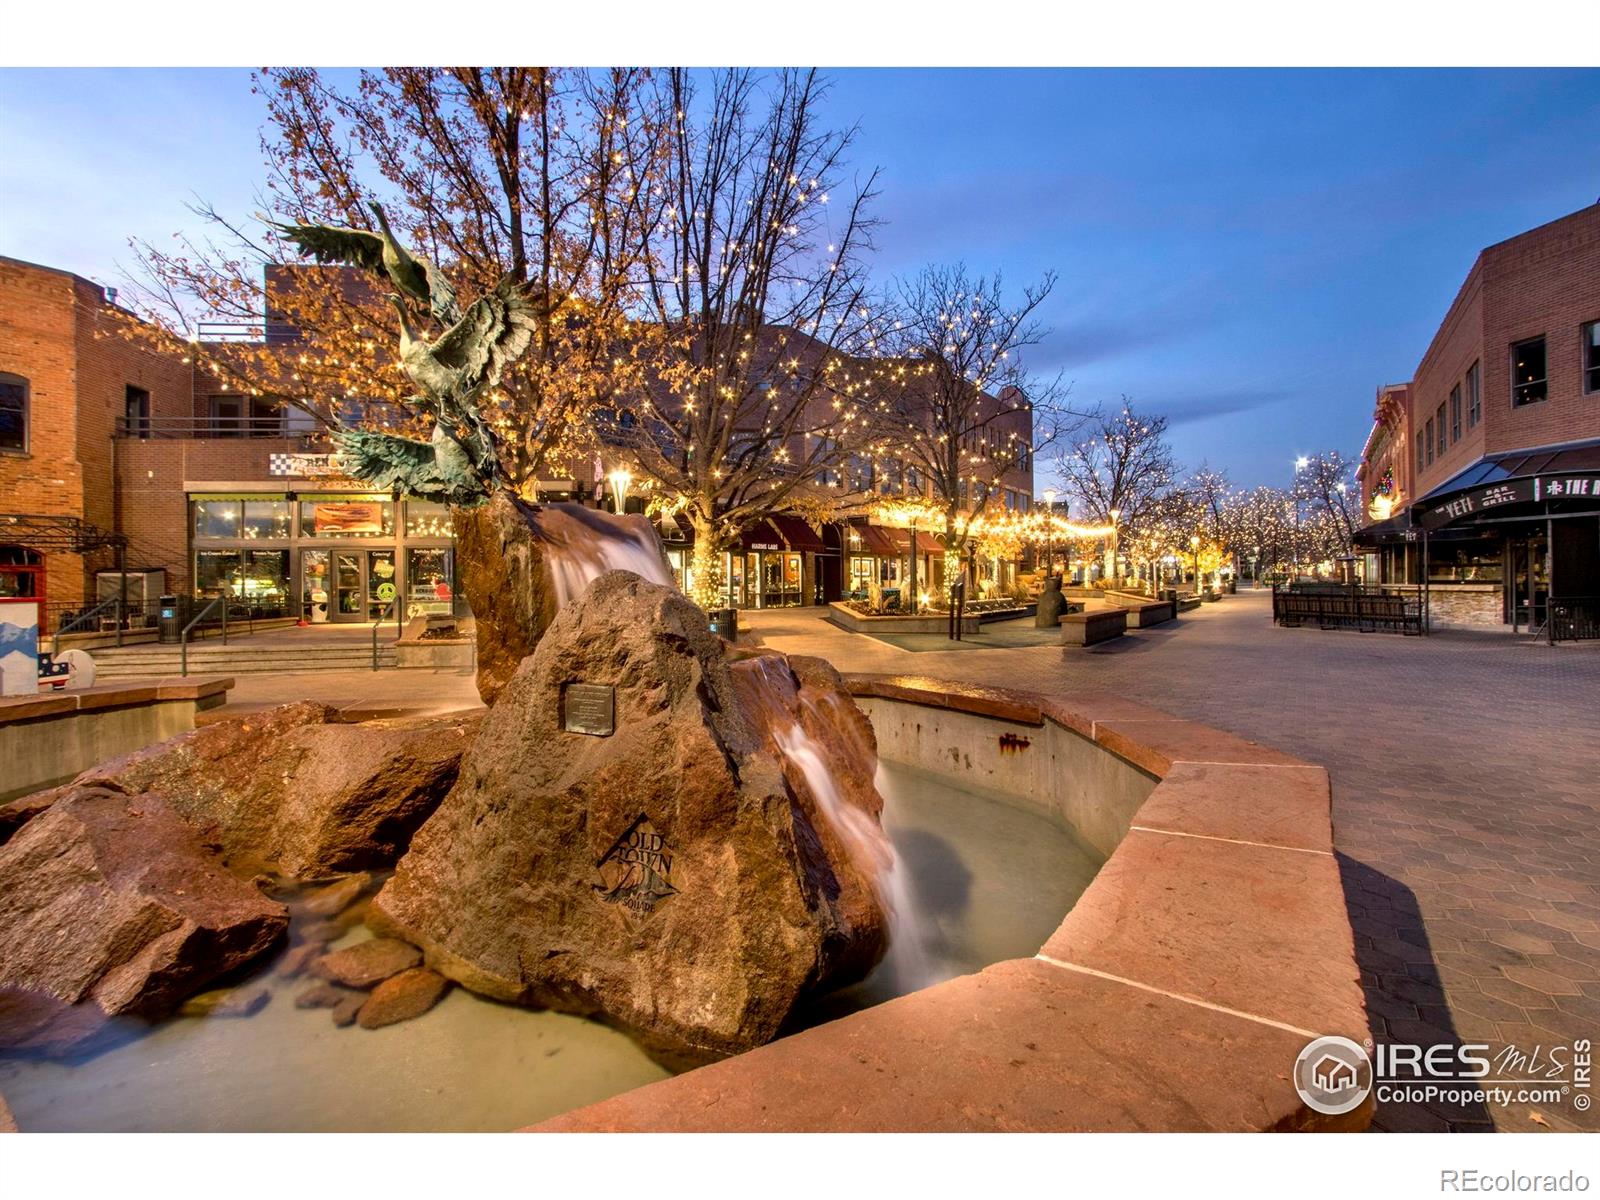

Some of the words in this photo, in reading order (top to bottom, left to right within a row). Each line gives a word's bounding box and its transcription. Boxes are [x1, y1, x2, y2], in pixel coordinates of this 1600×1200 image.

[1486, 486, 1509, 496] BAR
[1565, 480, 1588, 495] THE
[1446, 496, 1474, 518] YETI
[1482, 495, 1516, 507] GRILL
[628, 831, 666, 852] OLD
[617, 846, 674, 875] TOWN
[622, 898, 657, 913] SQUARE
